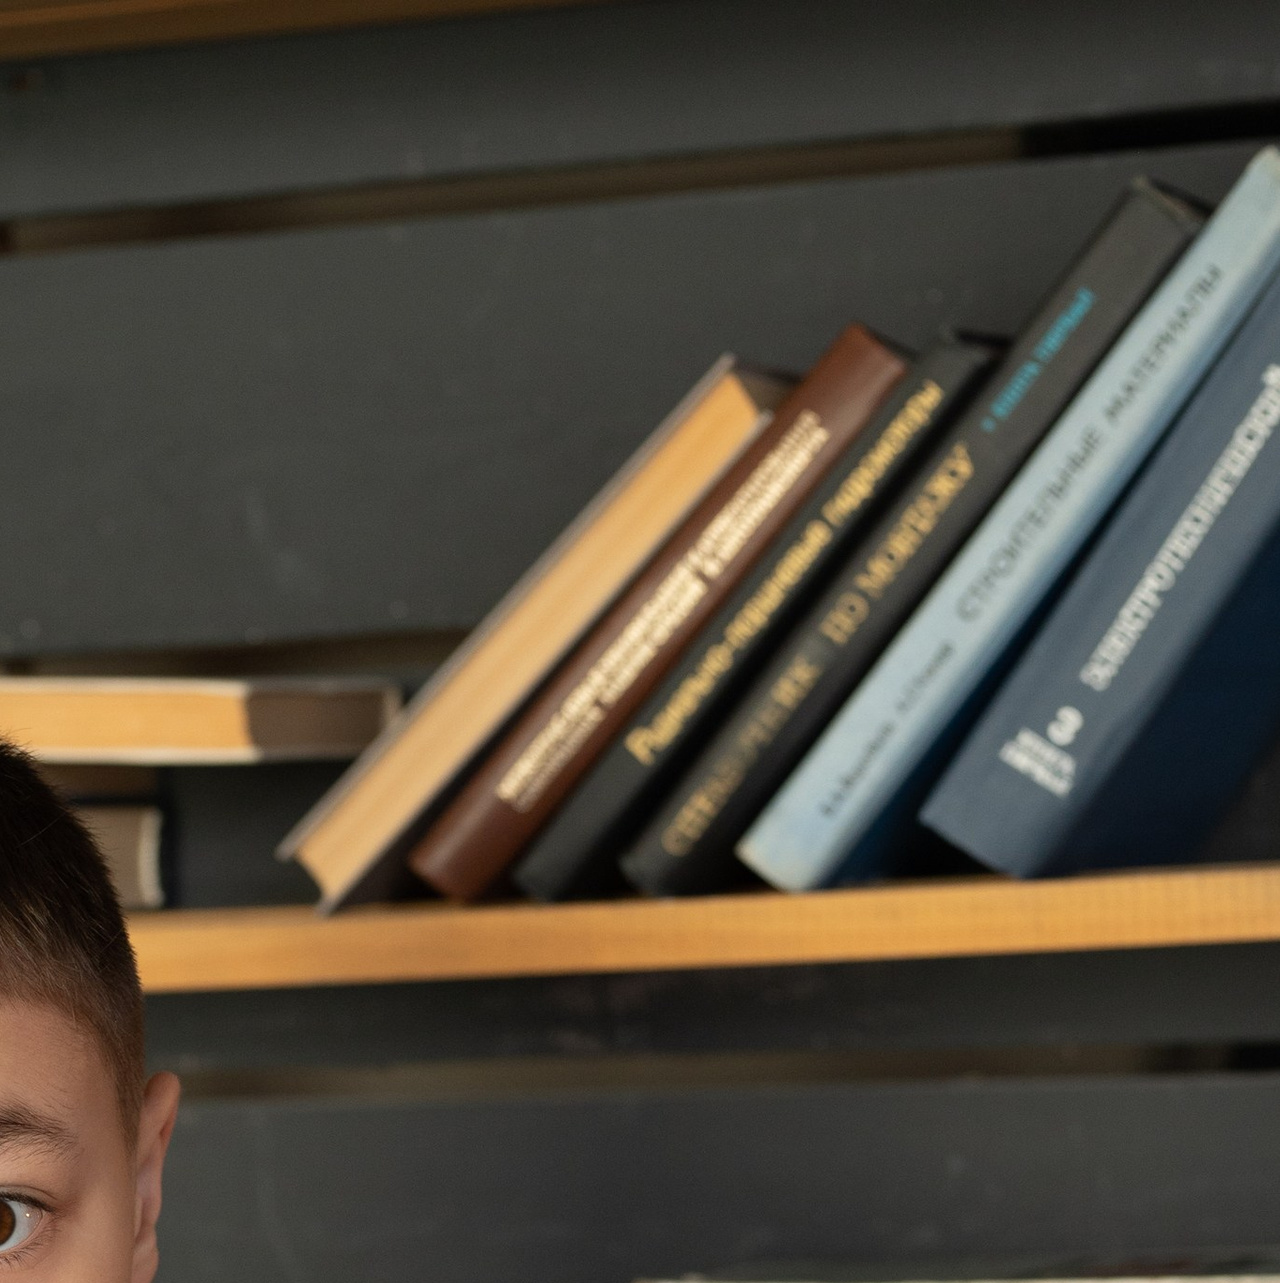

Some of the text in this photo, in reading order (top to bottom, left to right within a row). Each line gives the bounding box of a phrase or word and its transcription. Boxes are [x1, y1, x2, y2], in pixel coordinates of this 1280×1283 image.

[857, 441, 976, 594] МОНТАЖУ
[957, 263, 1225, 623] СТРОИТЕЛЬНЫЕ МАТЕРИАЛЫ
